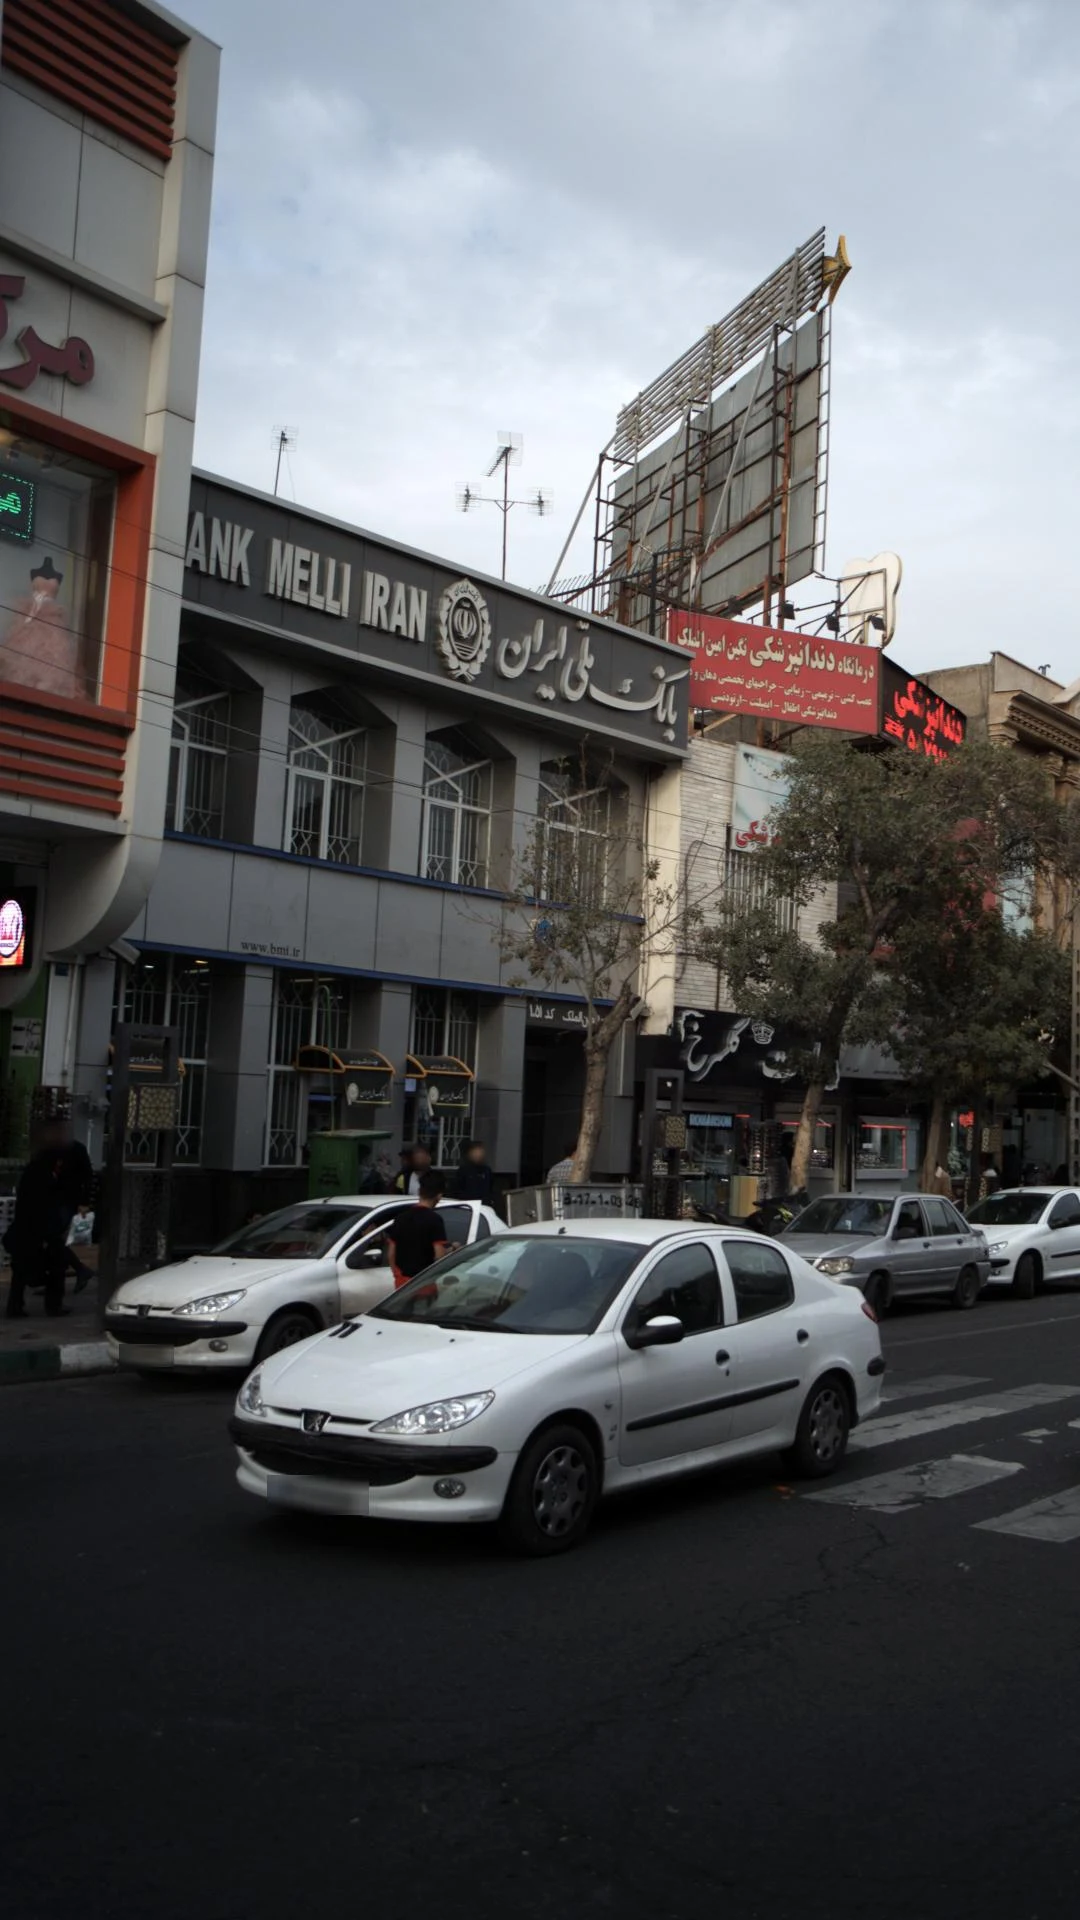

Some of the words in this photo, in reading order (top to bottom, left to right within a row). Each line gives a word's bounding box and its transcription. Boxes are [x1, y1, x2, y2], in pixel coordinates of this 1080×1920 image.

[184, 511, 255, 587] ANK
[265, 537, 351, 619] MELLI
[359, 570, 428, 642] IRAN
[496, 619, 568, 701] ایران
[705, 633, 726, 656] امین
[727, 636, 748, 661] نگین
[750, 636, 836, 676] دندانپزشکی
[837, 655, 875, 684] درمانگاه
[589, 665, 690, 742] بانک
[241, 942, 301, 958] www.bmi.ir
